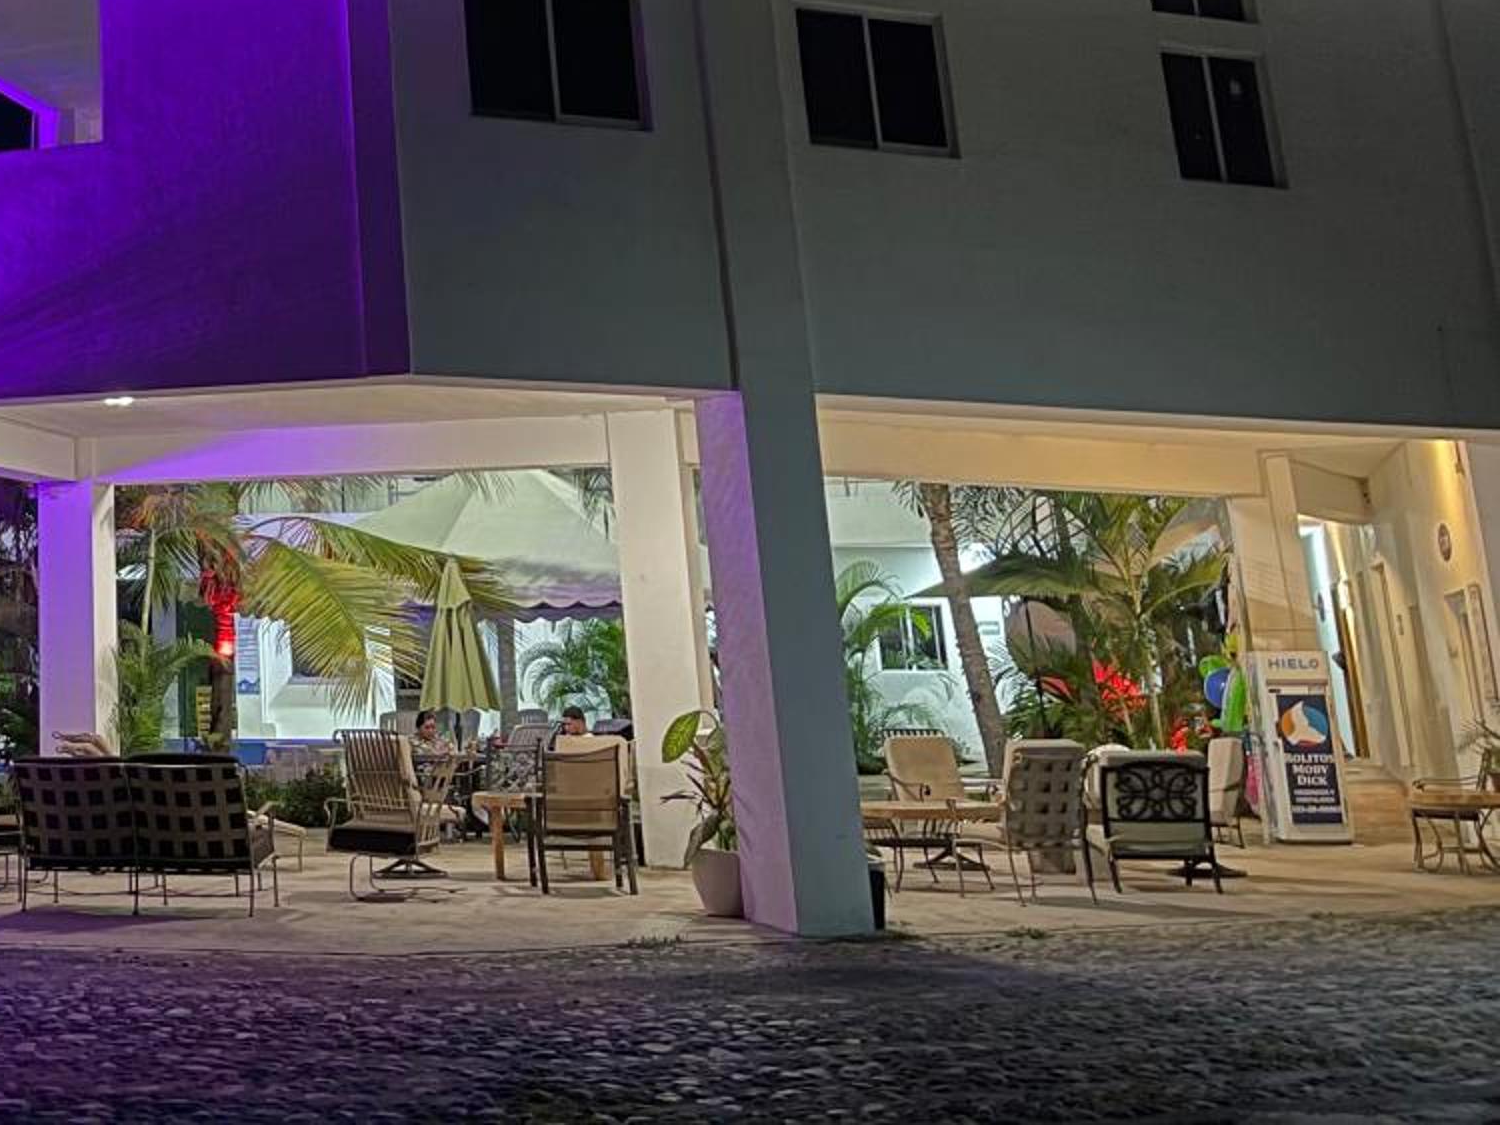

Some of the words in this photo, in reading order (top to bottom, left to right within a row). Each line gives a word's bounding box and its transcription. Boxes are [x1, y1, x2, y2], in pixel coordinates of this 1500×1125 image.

[1267, 658, 1319, 670] HIELO
[1291, 764, 1329, 774] MOBY
[1297, 775, 1328, 786] DICK
